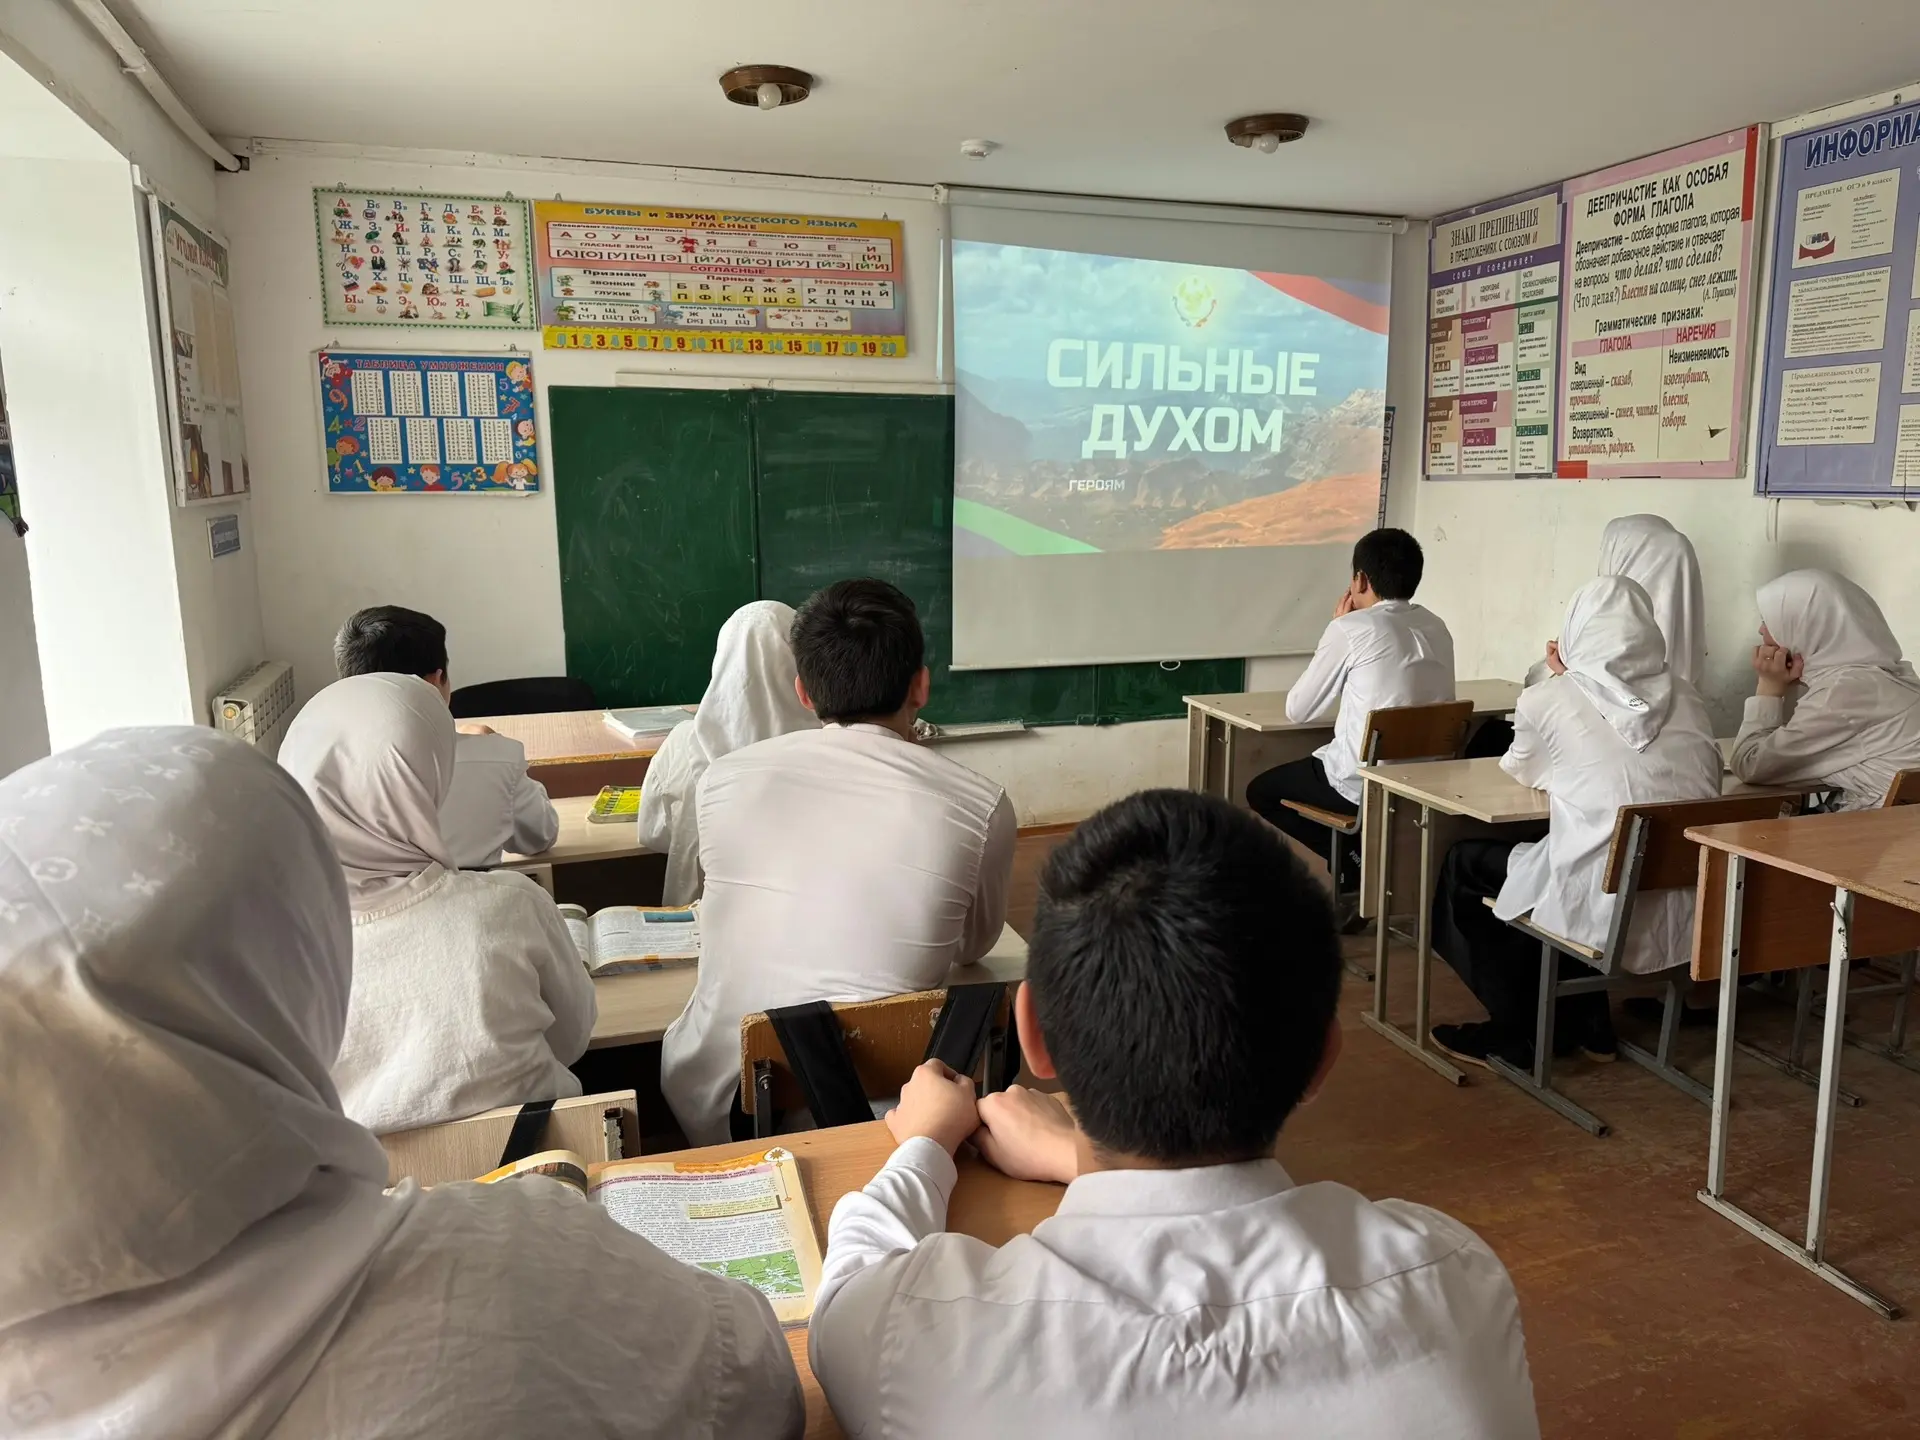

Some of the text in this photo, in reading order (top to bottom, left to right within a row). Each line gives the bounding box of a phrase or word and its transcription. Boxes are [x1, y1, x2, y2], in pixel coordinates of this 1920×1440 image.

[1587, 162, 1728, 218] ДЕЕПРИЧАСТИЕ КАК ОСОБАЯ
[585, 208, 641, 217] БУКВЫ
[666, 212, 716, 221] ЗВУКИ
[723, 216, 800, 225] РУССКОГО
[806, 220, 858, 228] ЯЗЫКА
[1613, 193, 1694, 227] ФОРМА ГЛАГОЛА
[691, 222, 757, 230] ГЛАСНЫЕ
[1450, 208, 1539, 247] ЗНАКИ ПРЕПИНАНИЯ
[1576, 206, 1740, 257] Деепричастие особая форма глагола, которая
[1455, 242, 1497, 262] ПРЕДЛОЖЕНИЯХ
[1505, 233, 1530, 251] СОЮЗОМ
[1575, 228, 1725, 272] обозначает добавочное действие и отвечает
[583, 269, 647, 278] Признаки
[691, 265, 766, 275] СОГЛАСНЫЕ
[1574, 278, 1582, 288] на
[1583, 272, 1609, 290] вопросы
[1615, 267, 1631, 281] что
[1634, 257, 1662, 279] делая?
[1665, 257, 1683, 272] что
[1686, 244, 1723, 267] сделав?
[1573, 268, 1738, 312] (Что делая?) Блестя на солнце, снег лежит.
[1595, 306, 1704, 336] Грамматические признаки:
[1676, 323, 1716, 343] НАРЕЧИЯ
[572, 334, 876, 353] 1 3 5 7 9 11 13 15 17 19
[1600, 335, 1632, 353] ГЛАГОЛА
[355, 359, 504, 371] ТАБЛИЦА УМНОЖЕНИЯ
[1669, 346, 1730, 364] Неизменяемость
[1046, 338, 1320, 396] СИЛЬНЫЕ
[1574, 361, 1586, 375] Вид
[500, 378, 509, 390] 5
[1570, 376, 1605, 393] совершенный
[329, 389, 348, 410] 9
[353, 417, 366, 431] 2
[1569, 408, 1609, 423] несовершенный
[1081, 403, 1283, 459] ДУХОМ
[1573, 426, 1613, 441] Возвратность
[451, 467, 487, 489] 5 3
[1068, 478, 1125, 492] ГЕРОЯМ
